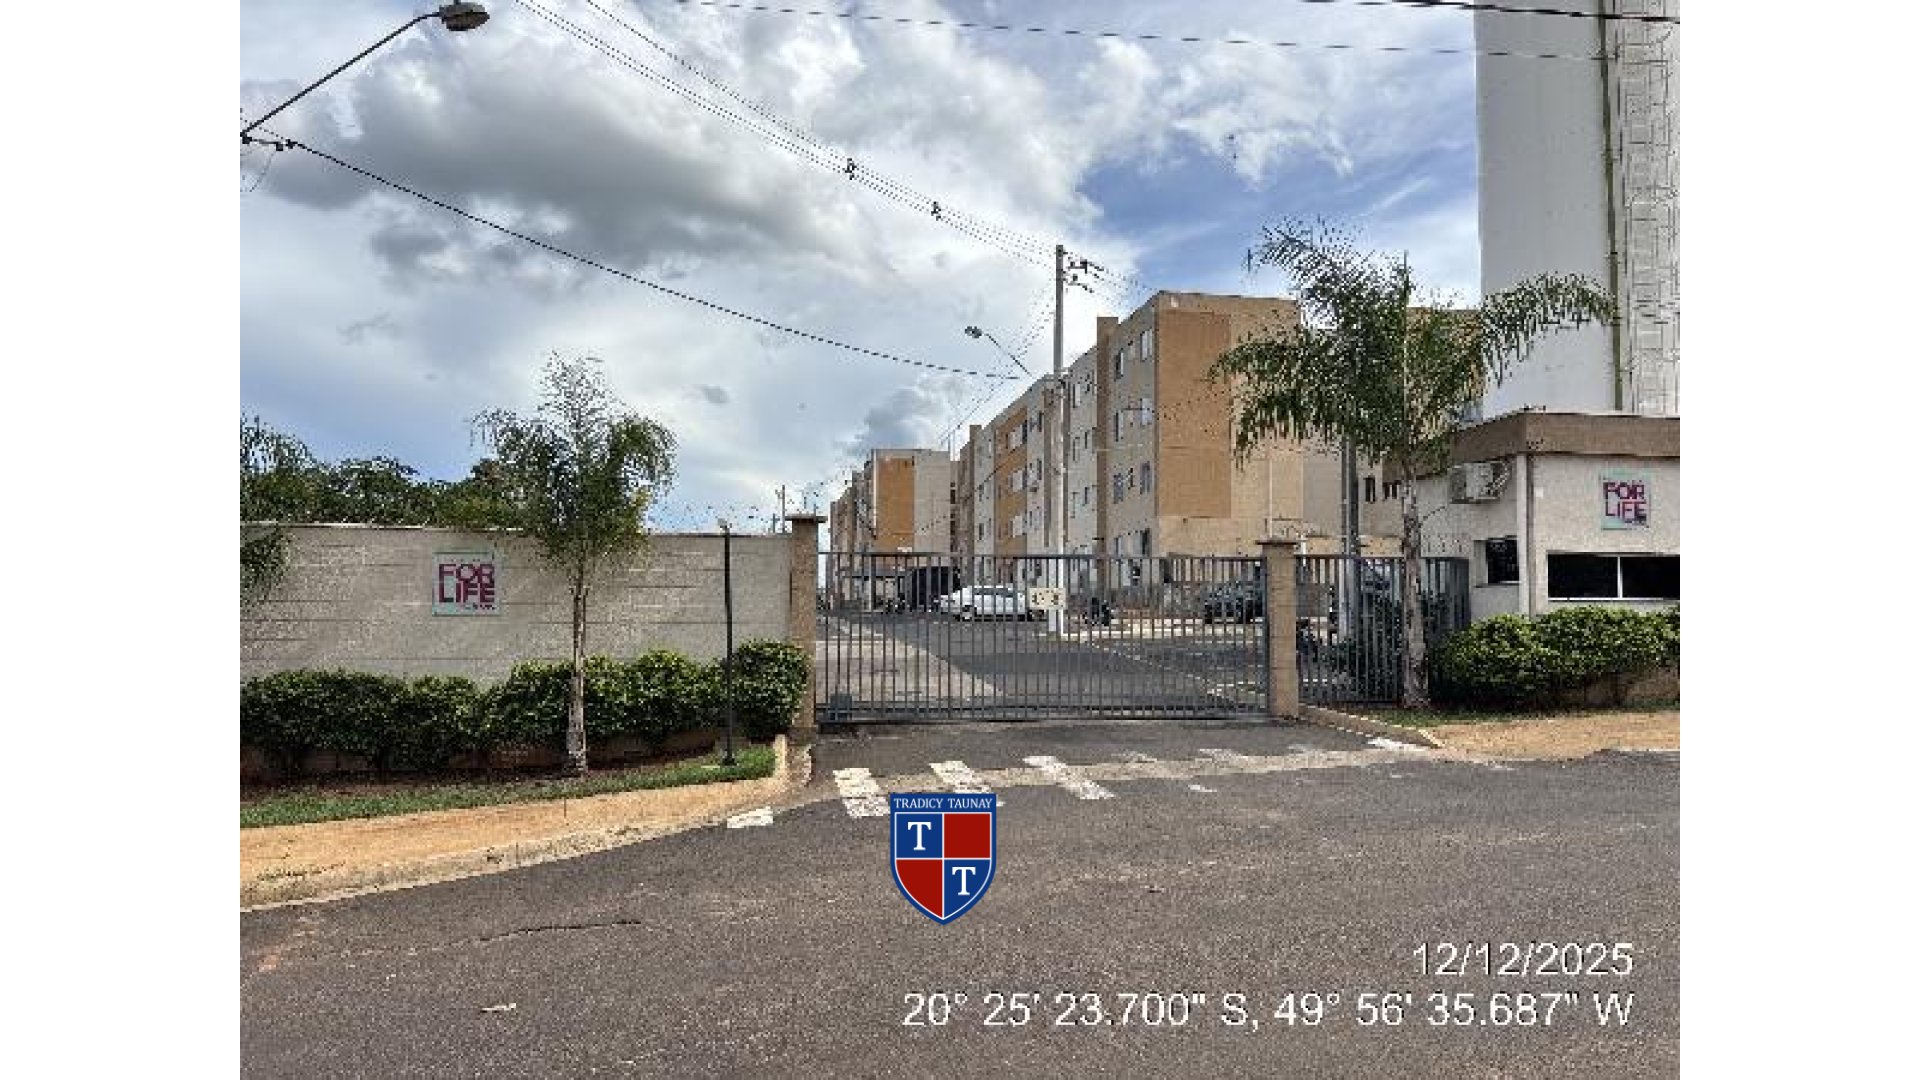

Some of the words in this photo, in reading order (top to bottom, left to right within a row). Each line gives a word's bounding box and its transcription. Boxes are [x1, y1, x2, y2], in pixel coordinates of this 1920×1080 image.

[1603, 482, 1645, 499] FOR
[1605, 501, 1646, 521] LIFE
[439, 564, 495, 583] FOR
[439, 582, 495, 603] LIFE
